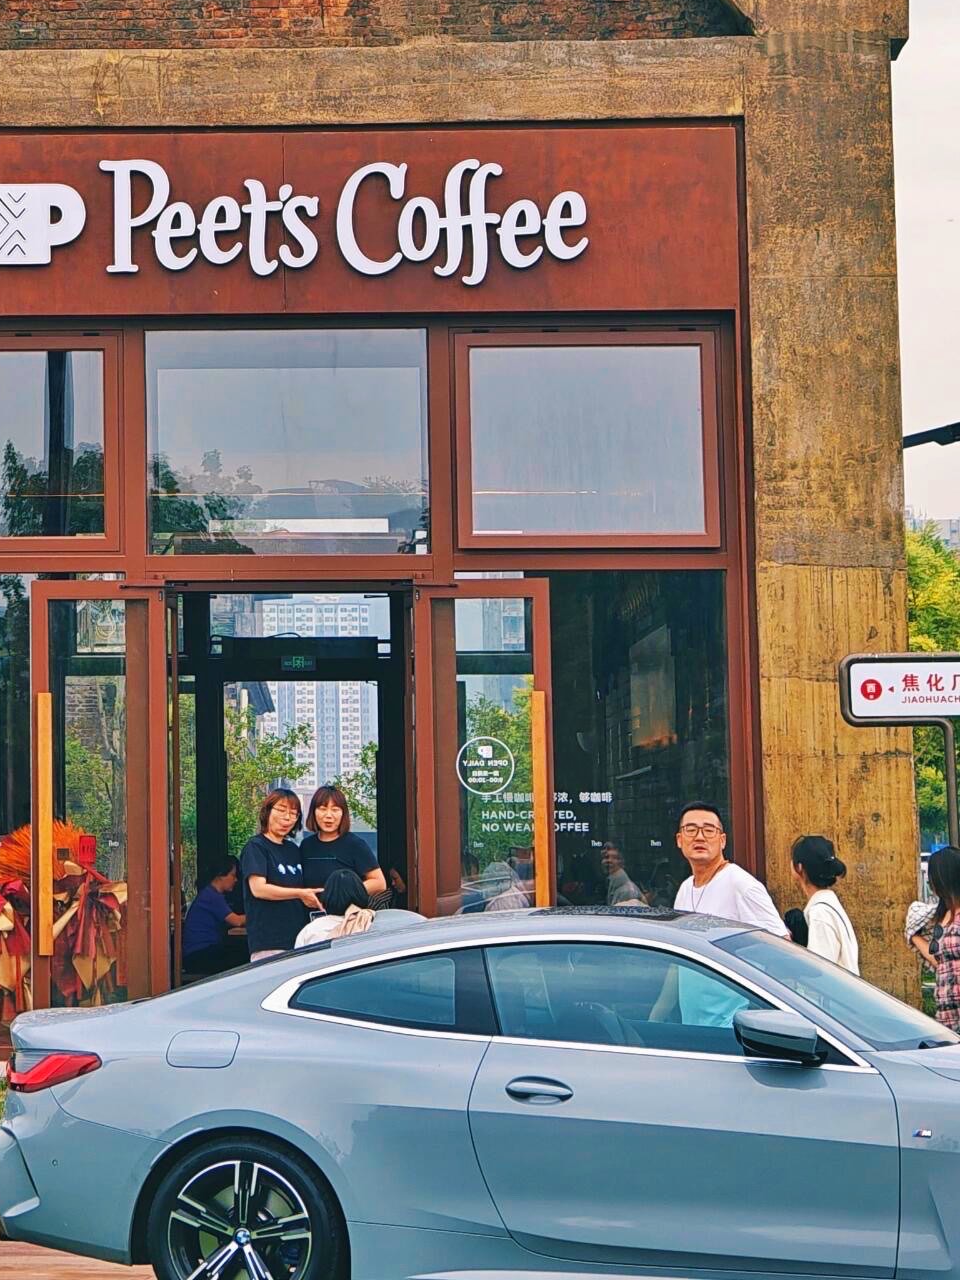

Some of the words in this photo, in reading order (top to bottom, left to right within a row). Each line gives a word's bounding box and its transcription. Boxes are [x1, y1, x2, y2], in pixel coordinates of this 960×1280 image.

[99, 159, 319, 276] Peet's
[336, 158, 589, 286] Coffee
[481, 823, 500, 832] NO
[503, 823, 535, 832] WEA
